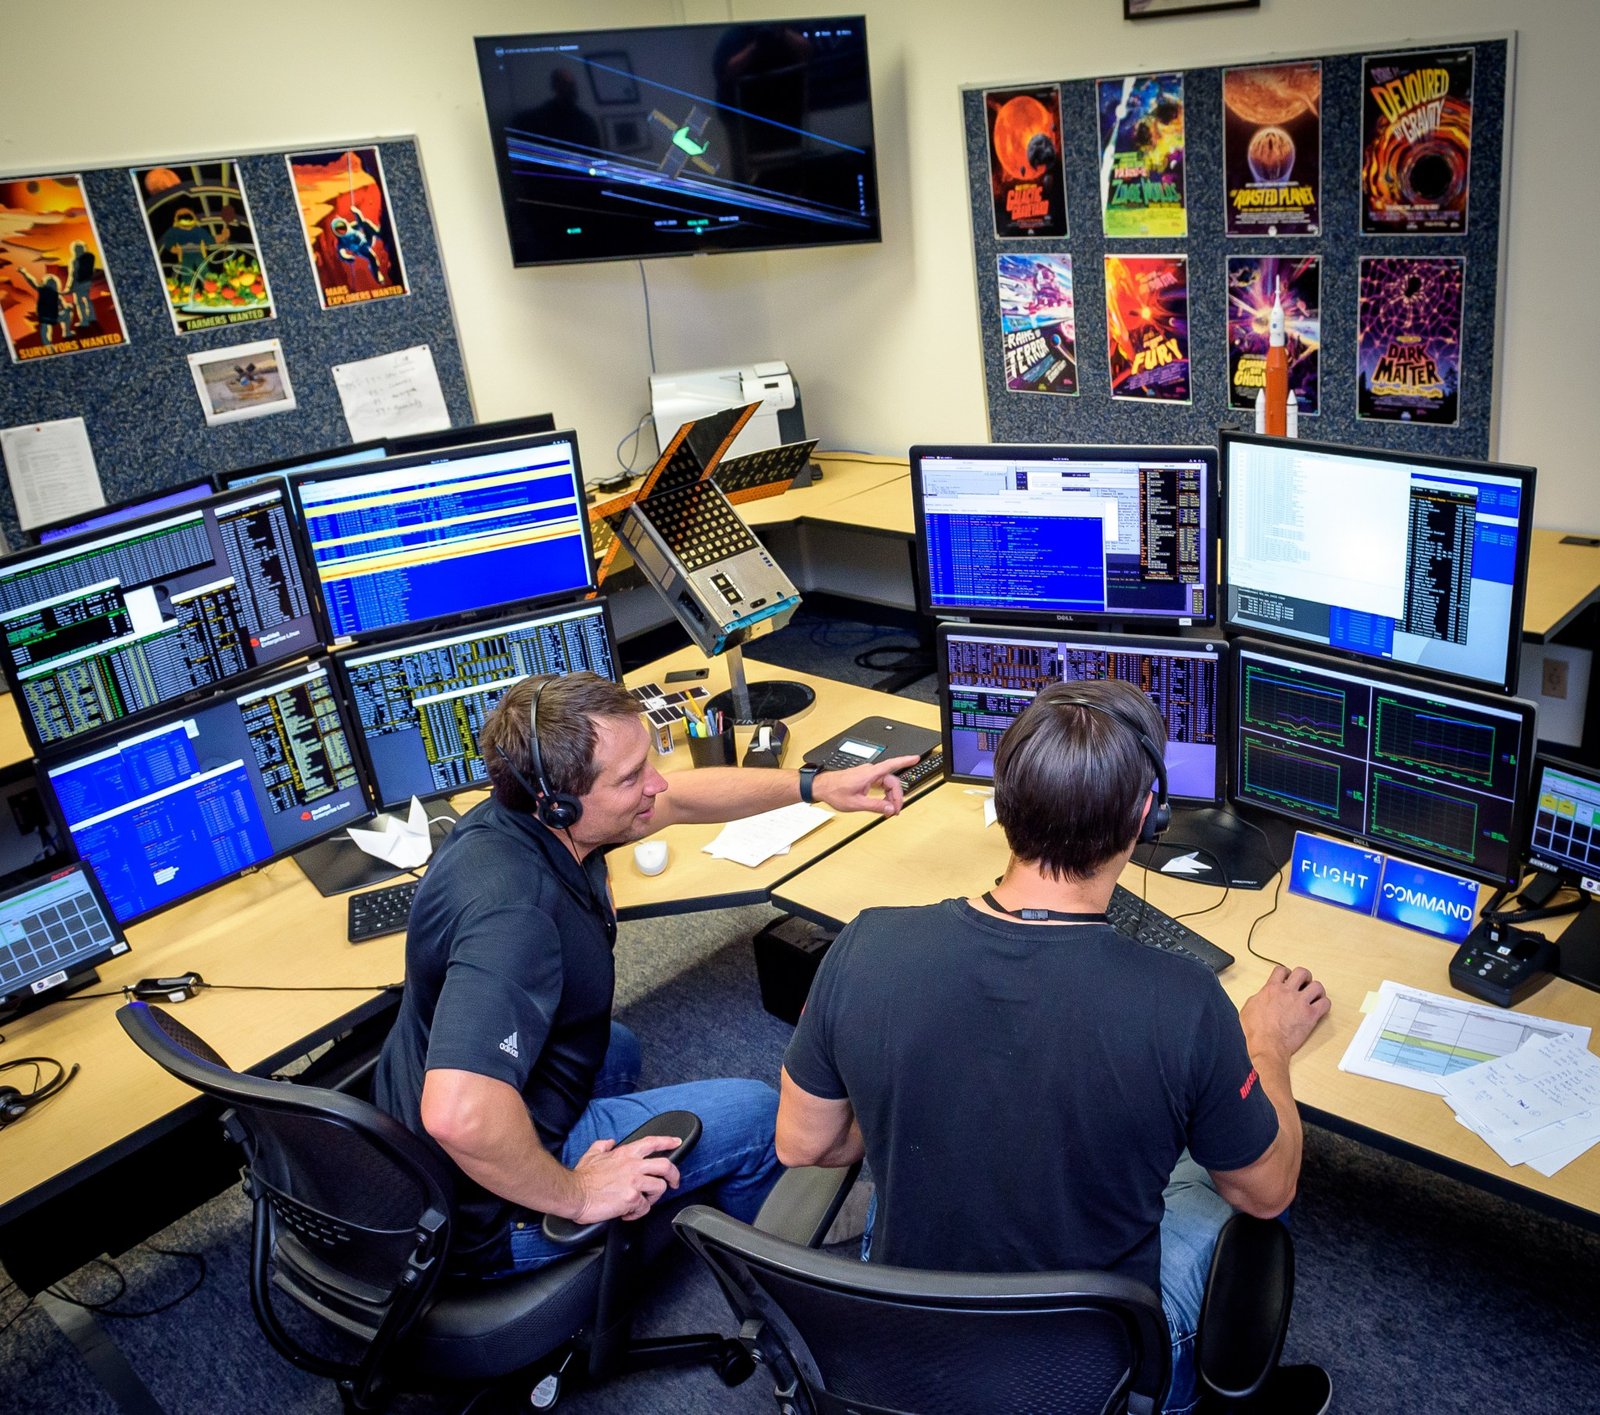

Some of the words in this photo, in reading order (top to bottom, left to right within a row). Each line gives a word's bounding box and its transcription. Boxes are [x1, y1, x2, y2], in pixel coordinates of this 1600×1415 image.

[1370, 67, 1450, 124] DEVOURED
[1401, 98, 1446, 144] GRAVITY
[1233, 188, 1277, 210] ROASTED
[1279, 186, 1315, 206] PLANET
[325, 285, 348, 297] MARS
[327, 290, 372, 306] EXPLORERS
[371, 285, 403, 298] WANTED
[186, 315, 227, 330] FARMERS
[228, 309, 264, 323] WANTED
[19, 341, 80, 359] SURVEYORS
[80, 333, 121, 348] WANTED
[1008, 329, 1036, 349] RAINS
[1008, 337, 1050, 378] TERROR
[1131, 338, 1183, 375] FURY
[1387, 343, 1429, 363] DARK
[1373, 357, 1442, 386] MATTER
[1301, 859, 1369, 889] FLIGHT
[1383, 883, 1472, 921] COMMAND
[499, 1042, 519, 1058] adidas
